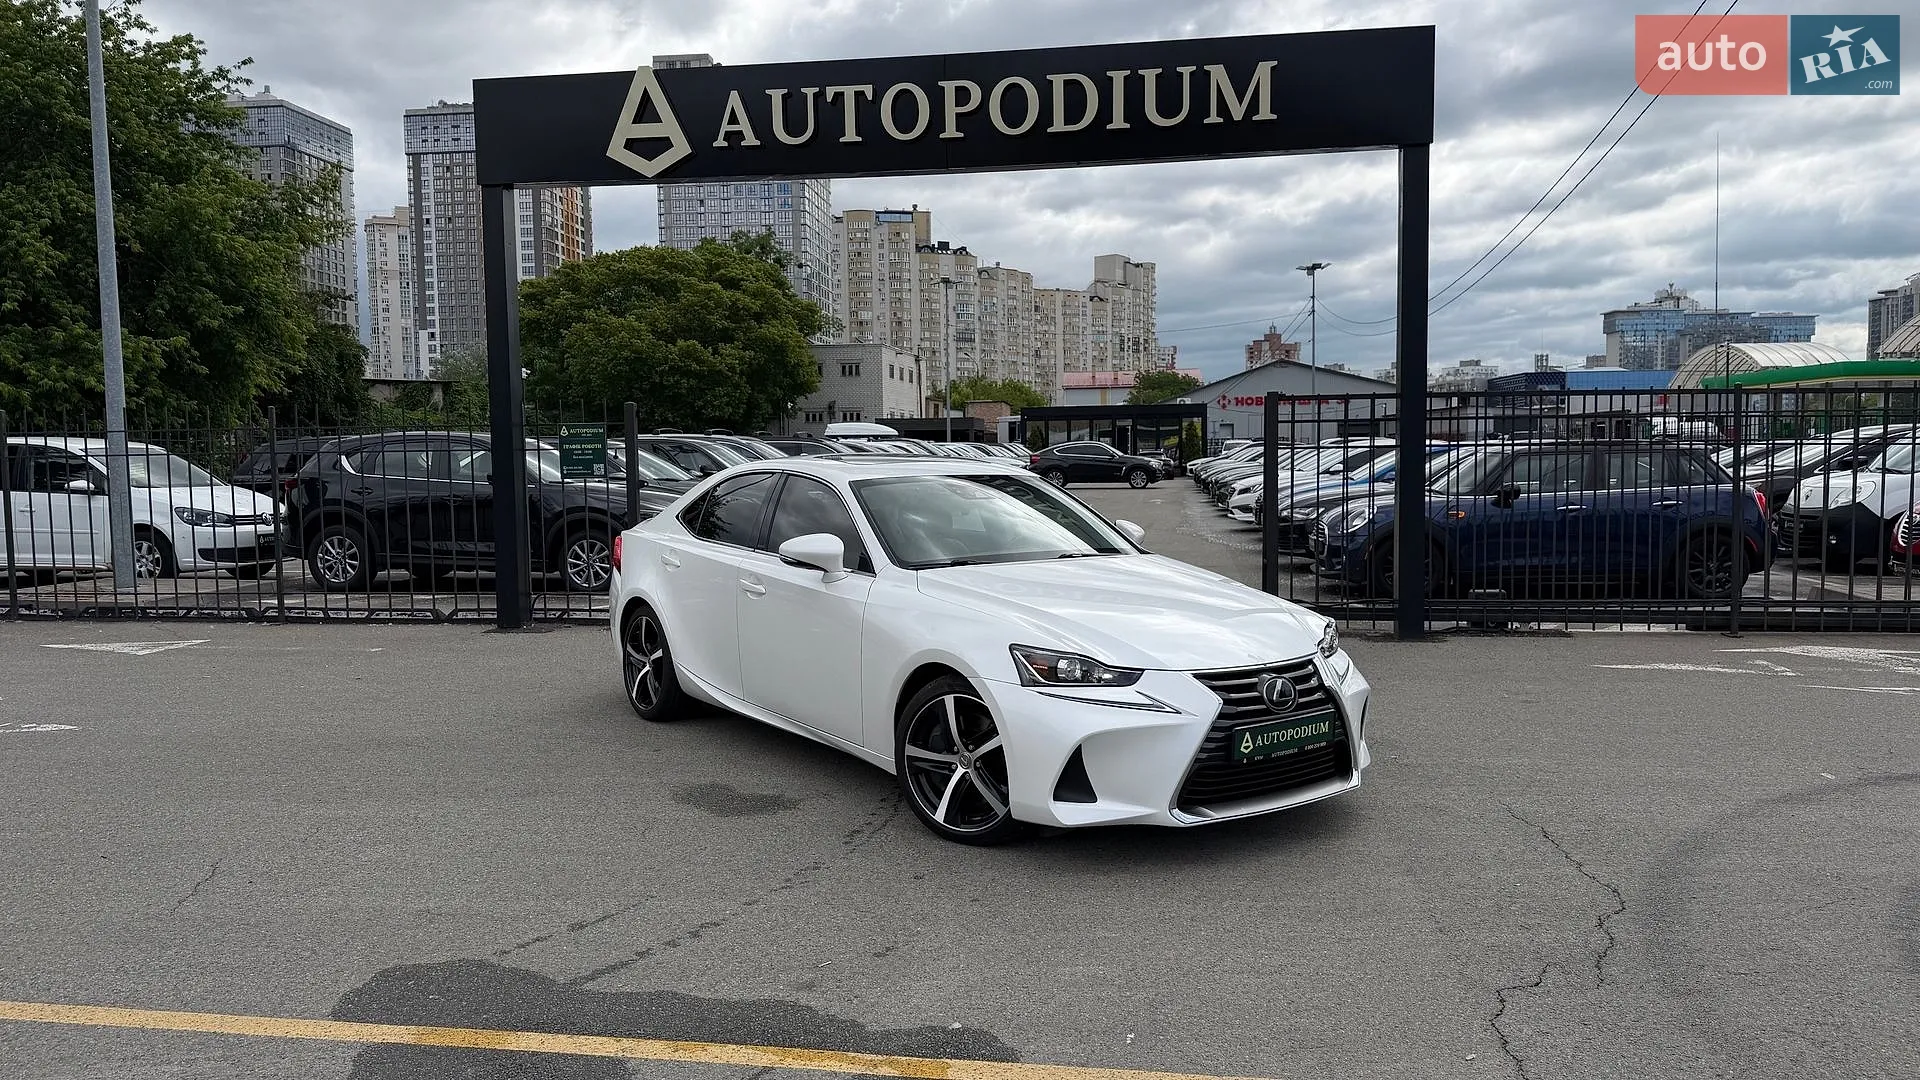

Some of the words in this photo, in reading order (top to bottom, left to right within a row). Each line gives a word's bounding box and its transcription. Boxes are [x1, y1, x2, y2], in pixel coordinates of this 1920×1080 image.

[712, 60, 1278, 147] AUTOPODIUM
[1234, 396, 1264, 406] НОВ
[1255, 721, 1329, 746] AUTOPODIUM
